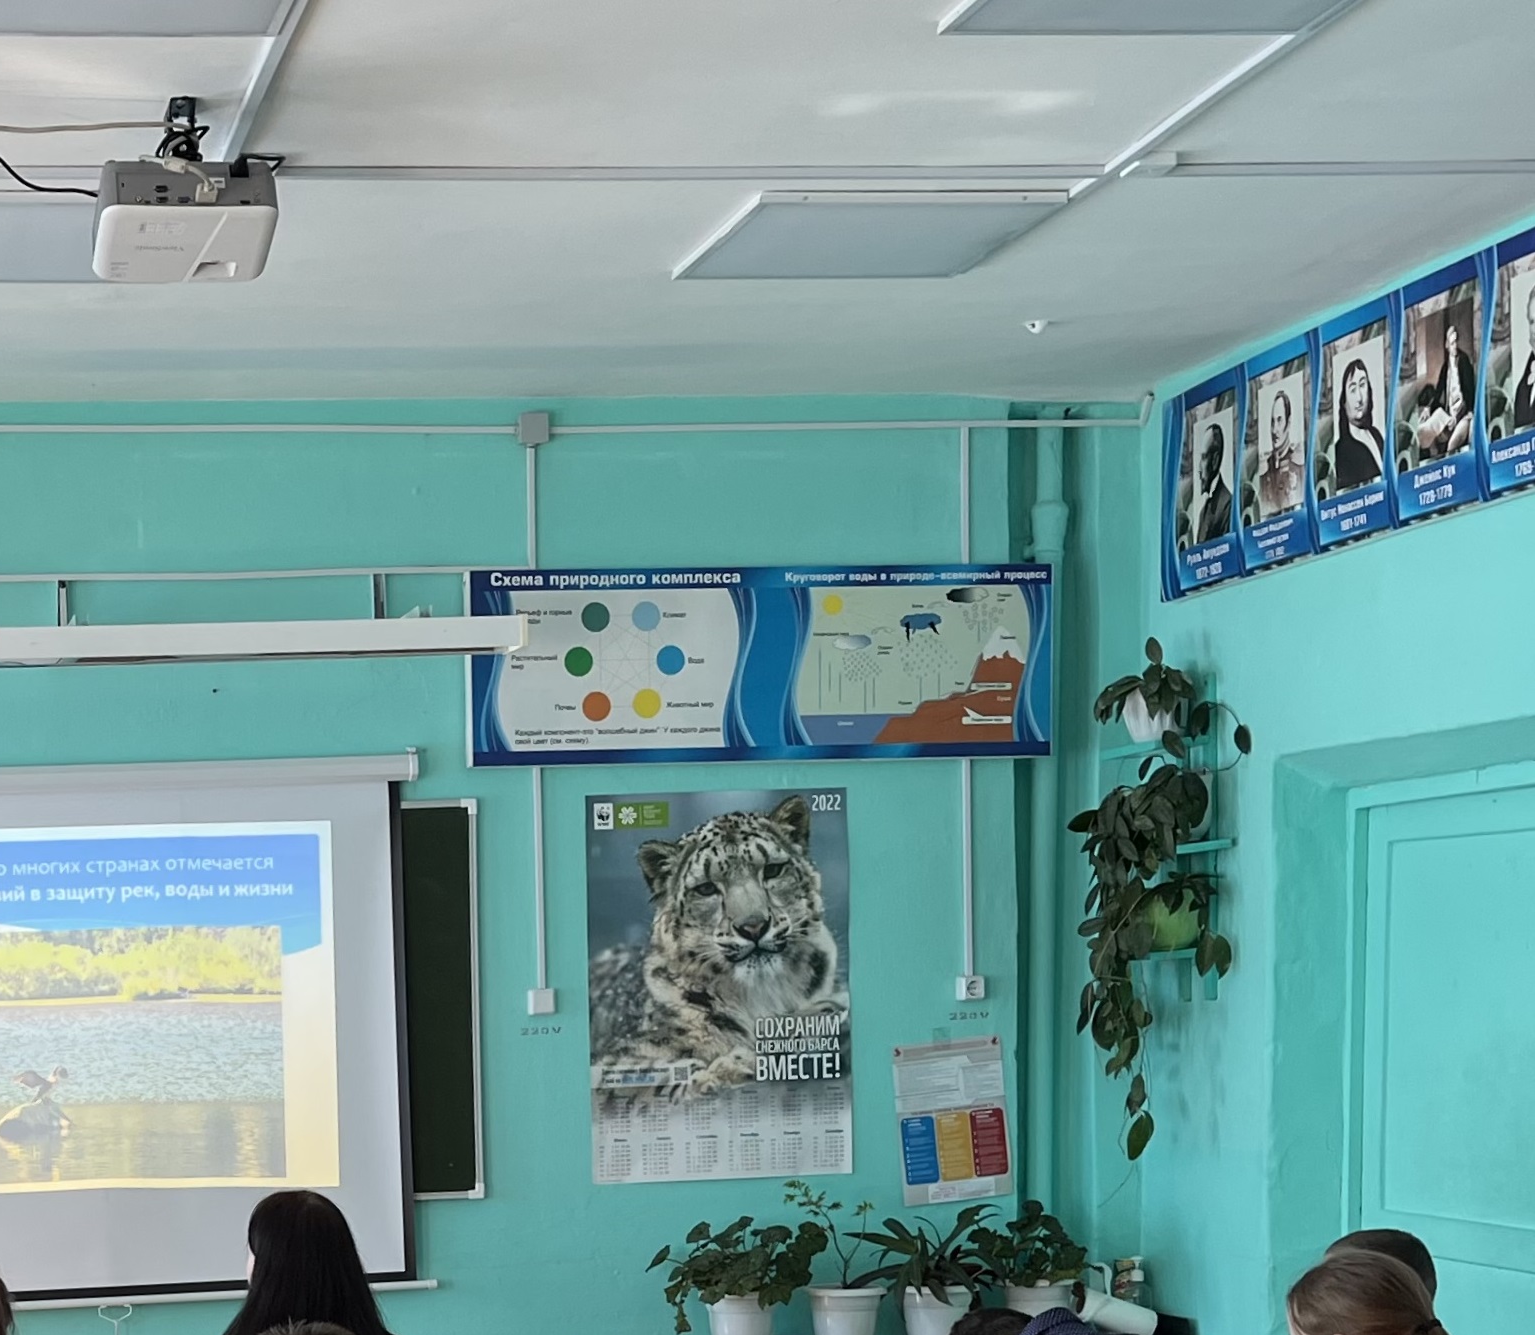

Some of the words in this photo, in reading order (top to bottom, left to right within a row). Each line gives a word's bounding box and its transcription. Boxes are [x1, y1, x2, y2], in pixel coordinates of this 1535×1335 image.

[490, 572, 544, 587] Схема
[549, 573, 647, 589] природного
[651, 572, 741, 585] комплекса
[785, 571, 846, 584] Круговорот
[849, 572, 877, 583] воды
[880, 573, 887, 581] в
[1004, 571, 1048, 582] процесс
[811, 794, 841, 811] 2022
[12, 861, 81, 877] многих
[85, 859, 160, 877] странах
[165, 857, 274, 870] отмечается
[30, 888, 41, 901] в
[46, 886, 116, 905] защиту
[121, 885, 160, 903] рек,
[165, 883, 214, 900] воды
[218, 884, 230, 897] и
[233, 883, 295, 898] жизни
[755, 1015, 841, 1039] СОХРАНИМ
[755, 1038, 806, 1054] СНЕЖНОГО
[807, 1037, 841, 1052] БАРСА
[755, 1052, 842, 1081] ВМЕСТЕ!
